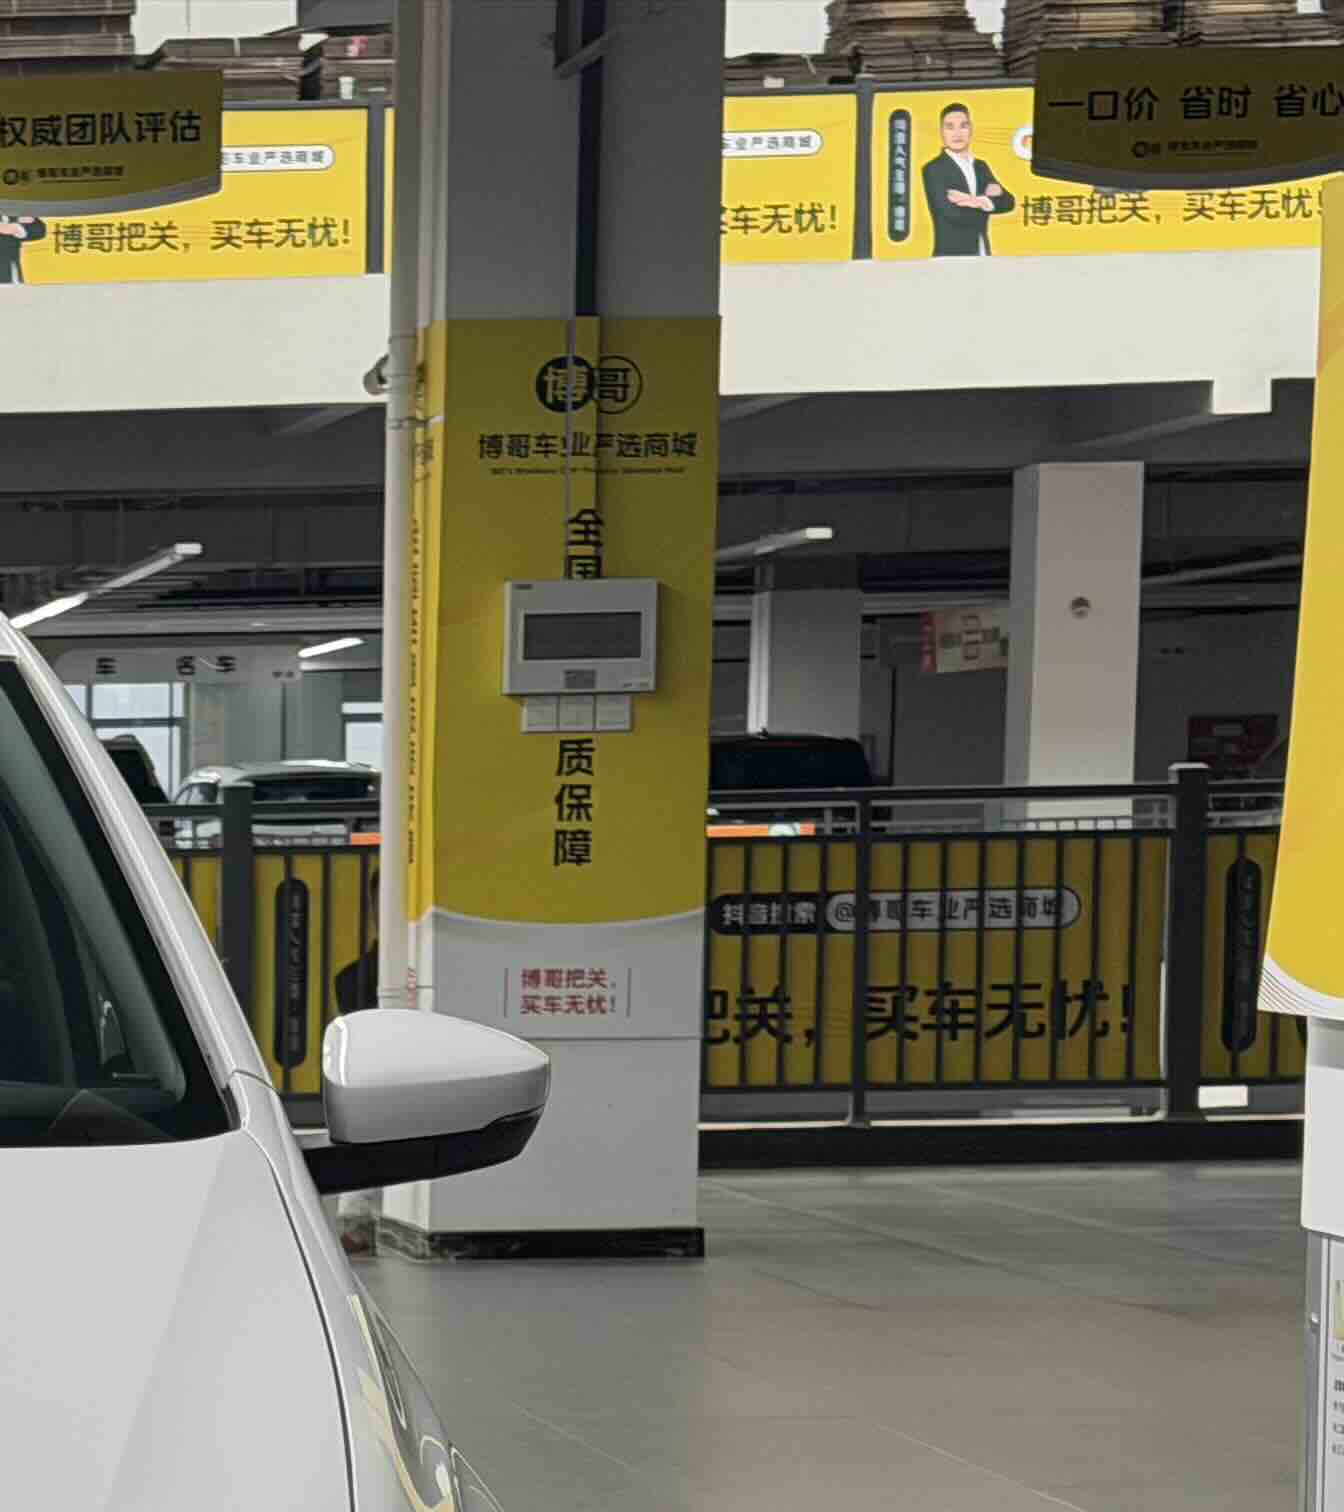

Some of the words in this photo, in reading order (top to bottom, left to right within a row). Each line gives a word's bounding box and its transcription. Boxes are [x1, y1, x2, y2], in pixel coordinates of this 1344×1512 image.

[1047, 86, 1160, 122] 一口价
[1180, 85, 1252, 120] 省时
[1273, 82, 1344, 119] 省心
[722, 204, 837, 237] 车无忧！
[552, 738, 596, 867] 质保障
